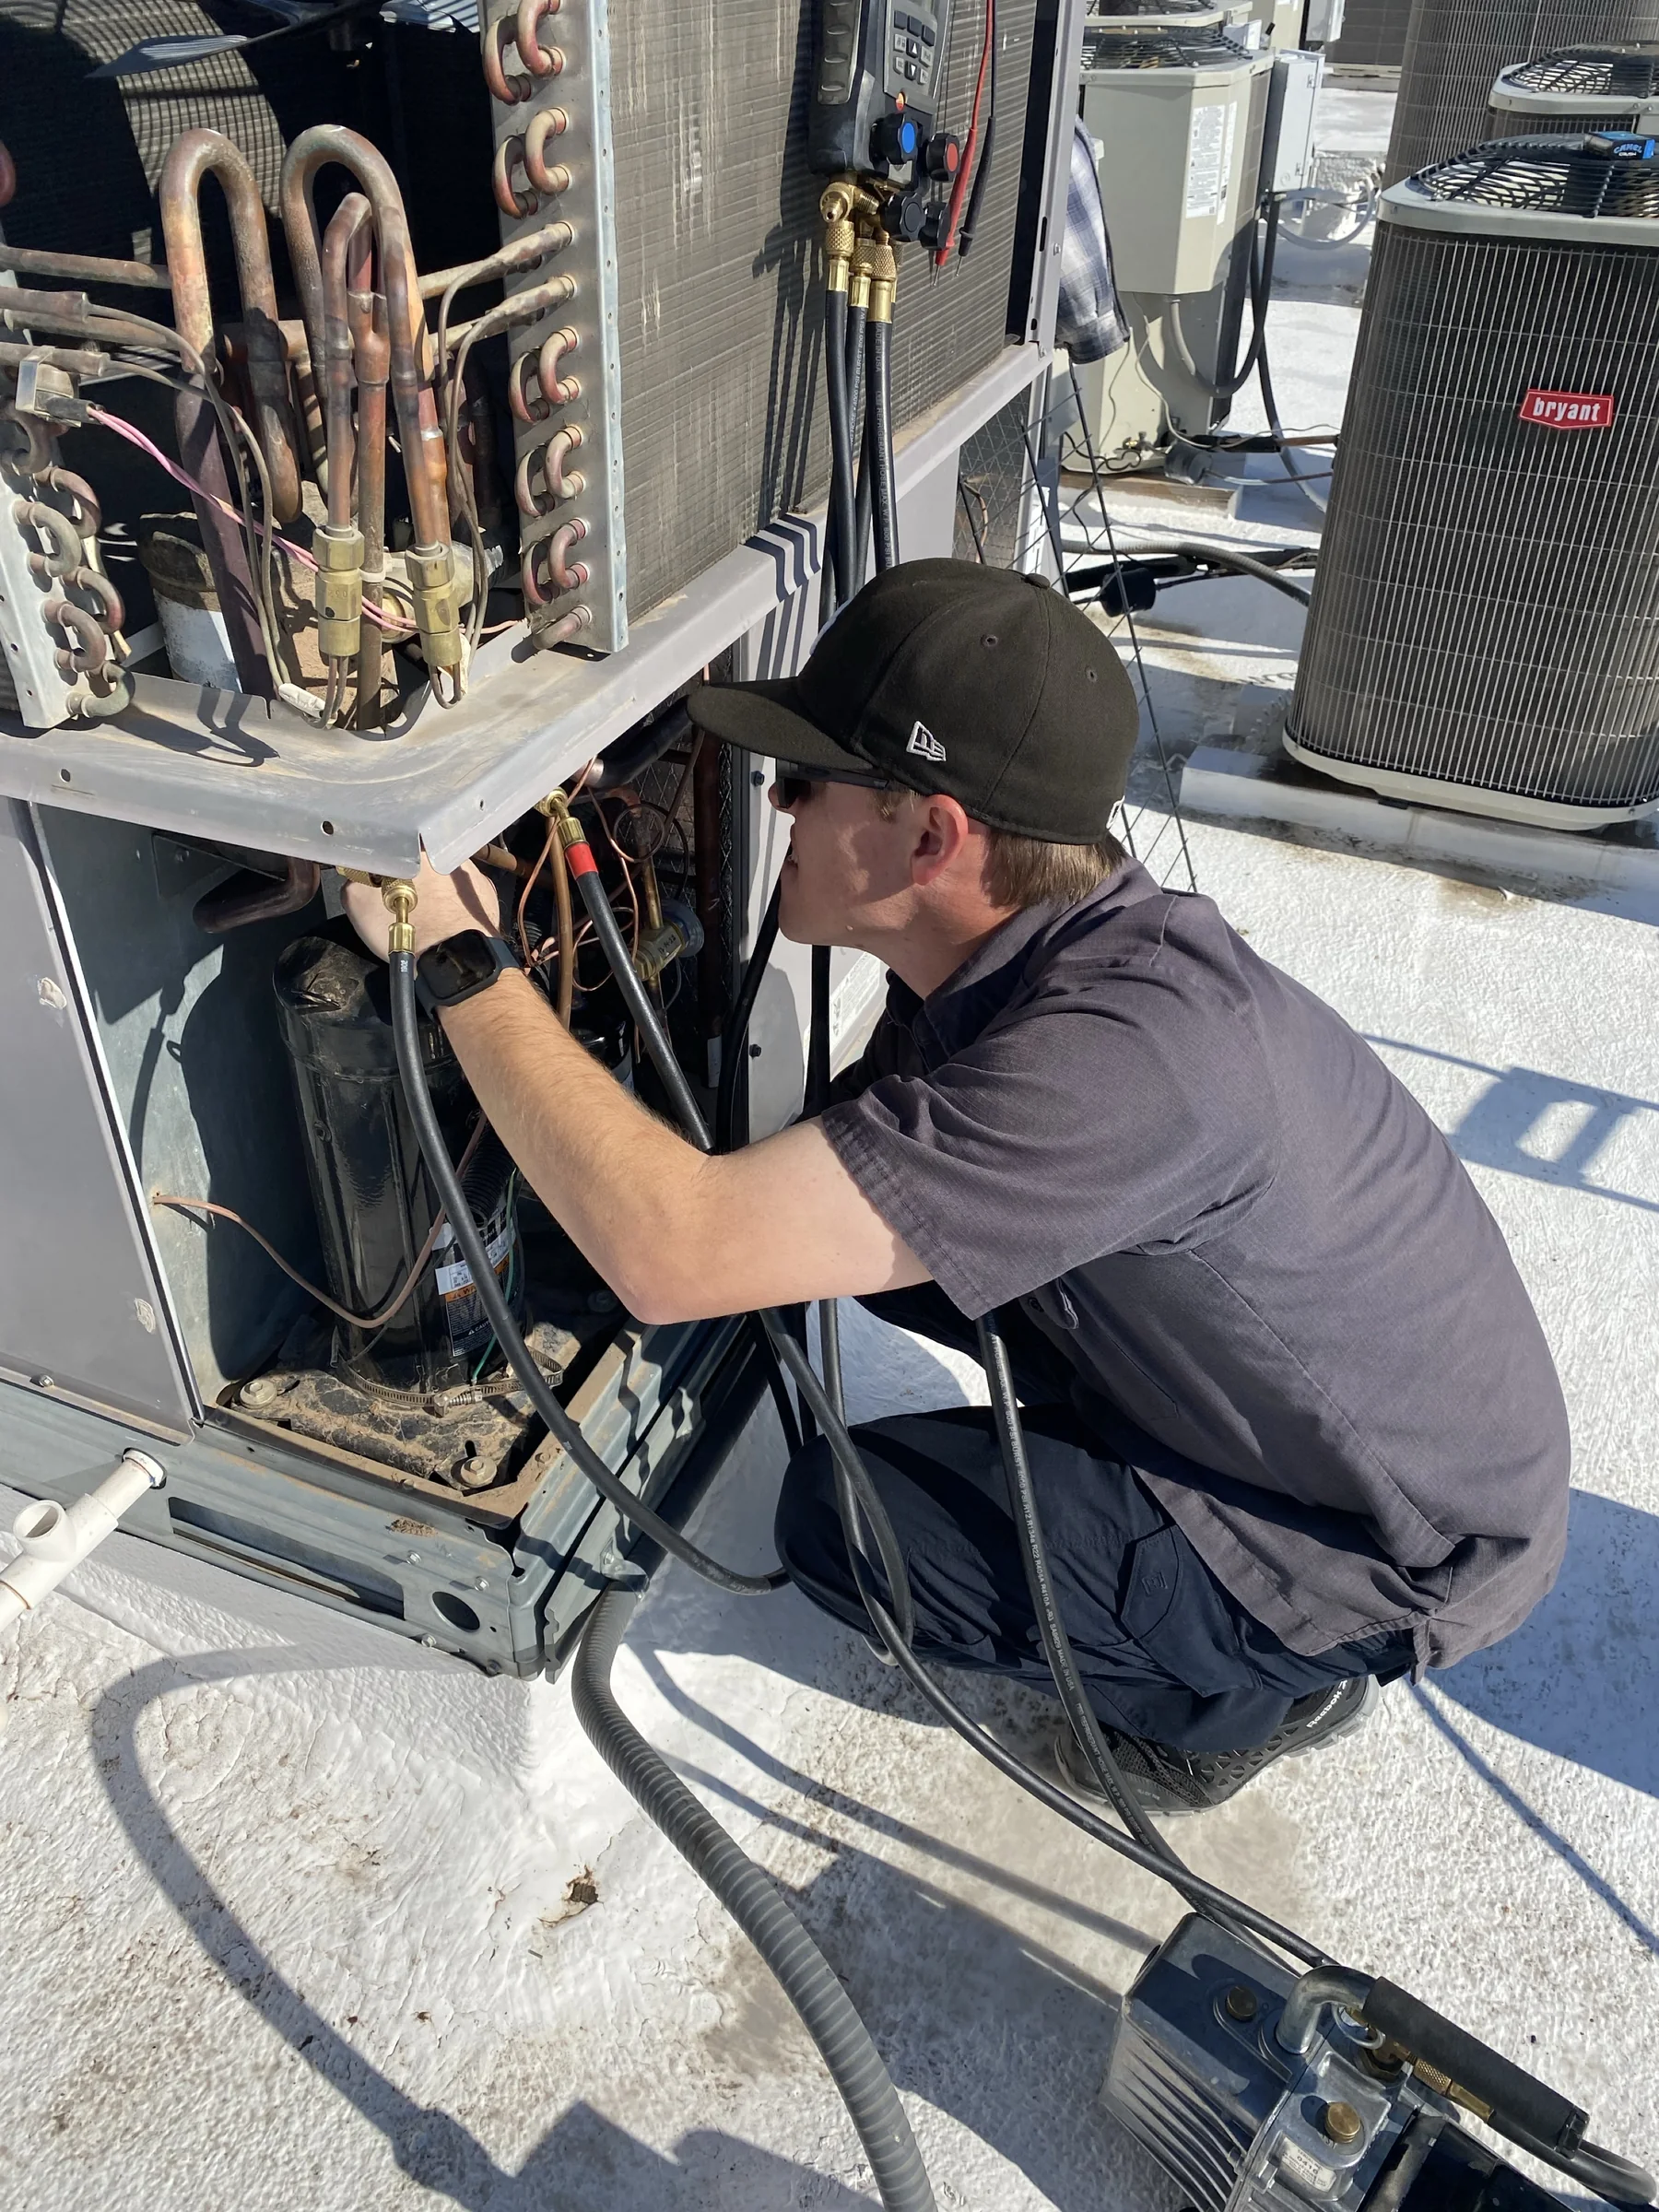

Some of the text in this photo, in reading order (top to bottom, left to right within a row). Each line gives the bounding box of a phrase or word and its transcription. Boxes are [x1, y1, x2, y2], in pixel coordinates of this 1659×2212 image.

[1613, 143, 1642, 154] CAMEL
[875, 345, 882, 354] IN
[1532, 396, 1601, 422] bryant
[877, 407, 885, 462] REFRIGERANT
[475, 1321, 490, 1332] CAUT
[1008, 1426, 1017, 1440] PSI
[1011, 1441, 1022, 1467] BURST
[1023, 1503, 1031, 1519] R12
[1026, 1520, 1036, 1544] R134a
[1031, 1544, 1040, 1559] R22
[1034, 1559, 1044, 1583] R404A
[1041, 1583, 1051, 1606] R410A
[1057, 1649, 1068, 1669] MADE
[1063, 1668, 1070, 1677] IN
[1065, 1676, 1075, 1691] USA
[1306, 1690, 1343, 1728] Reebok
[1081, 1715, 1100, 1756] REFRIGERANT
